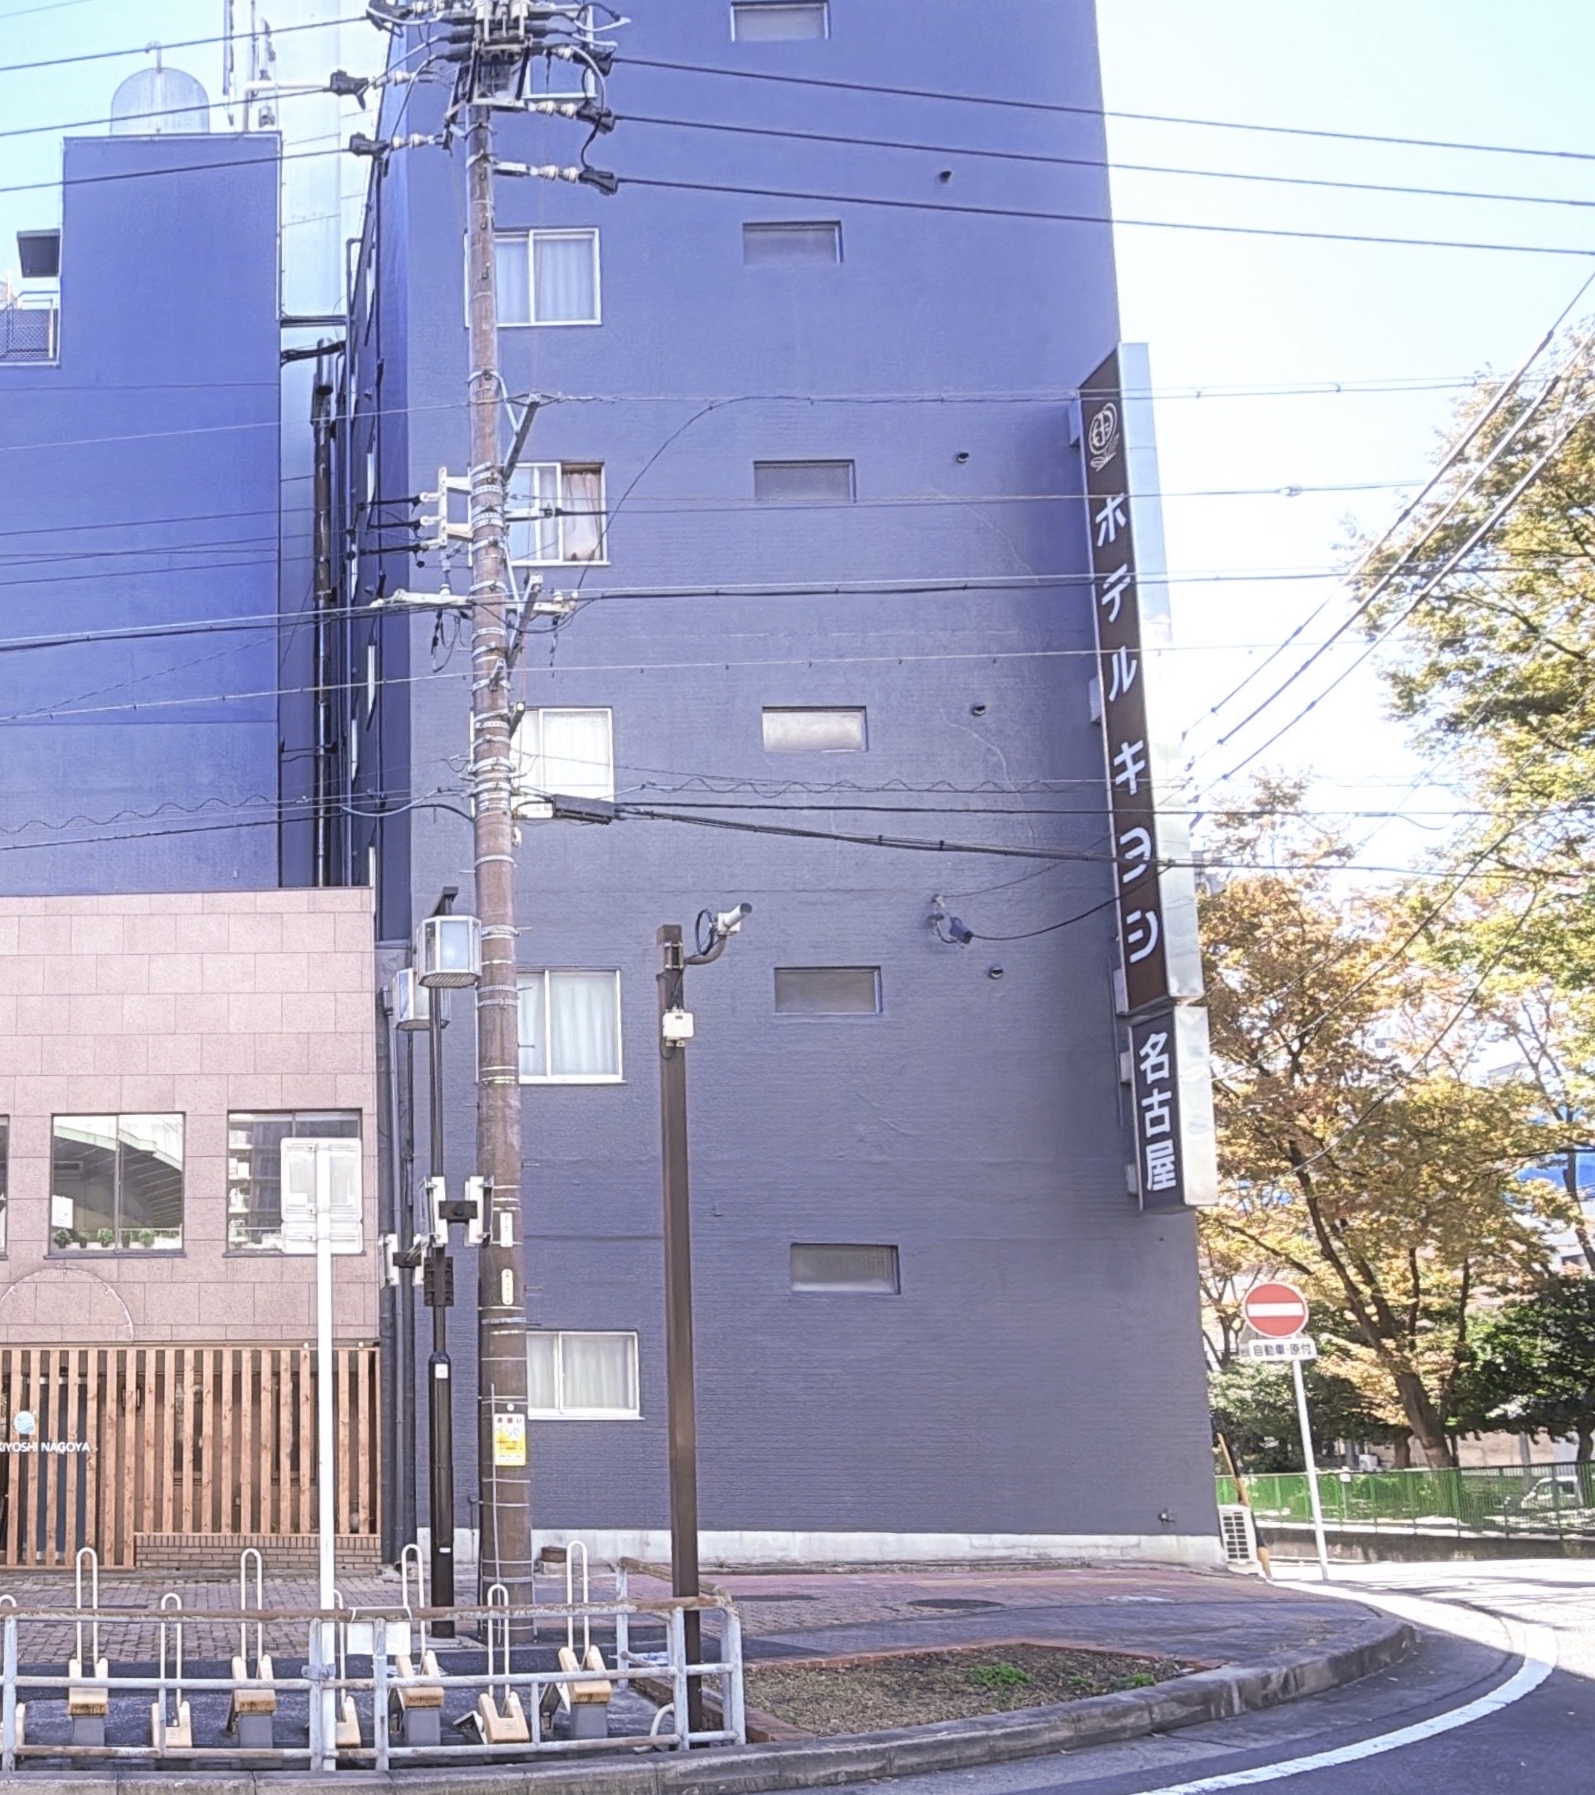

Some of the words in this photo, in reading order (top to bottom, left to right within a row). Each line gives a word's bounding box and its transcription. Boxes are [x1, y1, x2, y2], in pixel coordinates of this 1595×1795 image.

[1139, 1032, 1177, 1191] 名古屋
[41, 1441, 91, 1454] NAGOYA
